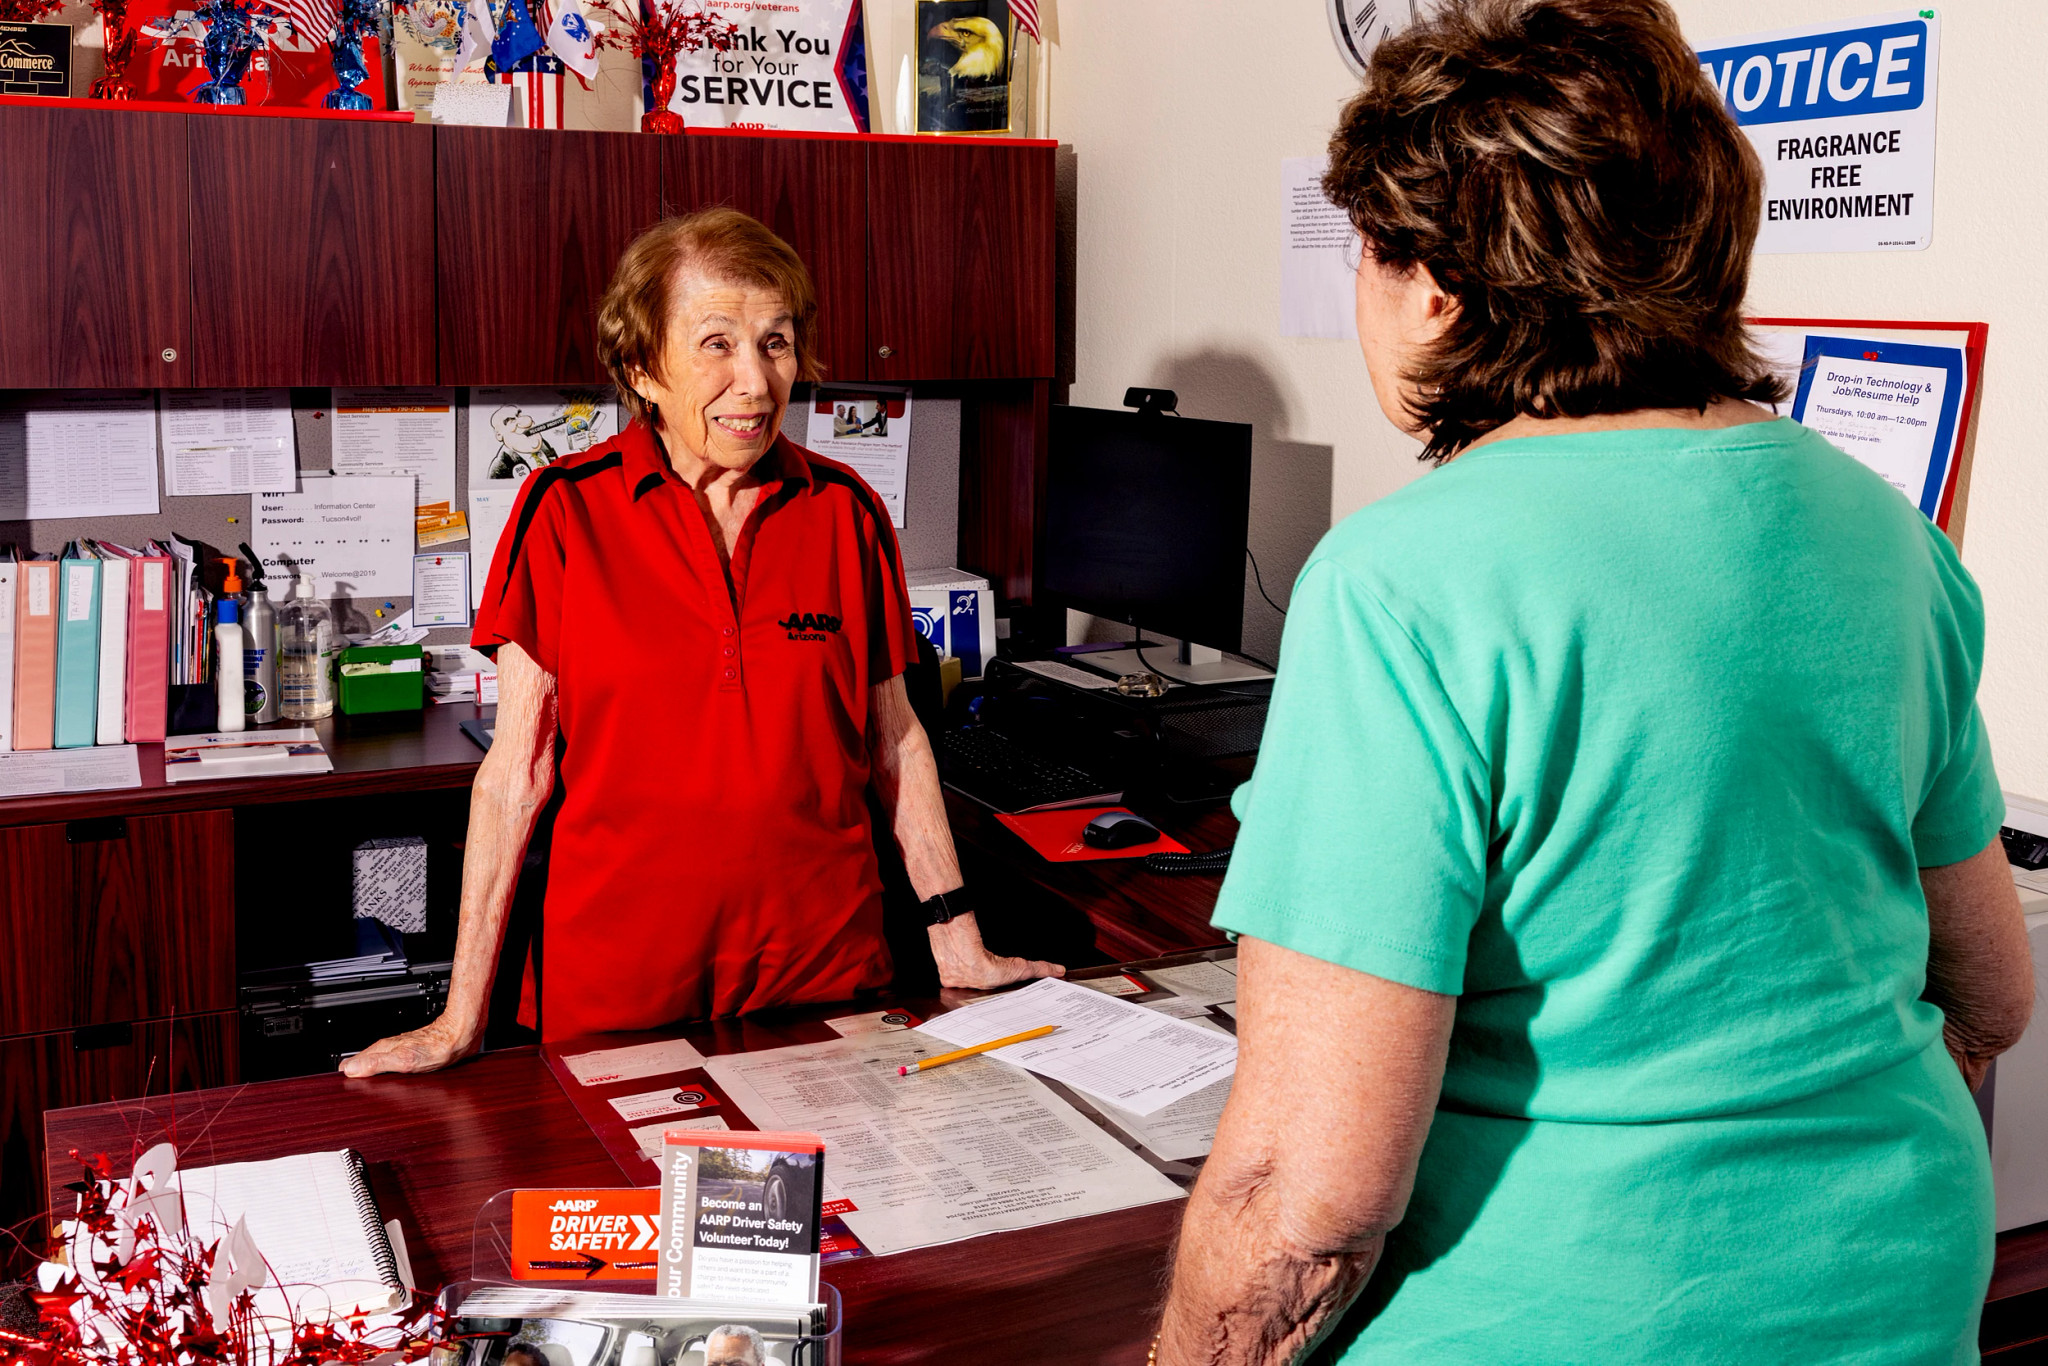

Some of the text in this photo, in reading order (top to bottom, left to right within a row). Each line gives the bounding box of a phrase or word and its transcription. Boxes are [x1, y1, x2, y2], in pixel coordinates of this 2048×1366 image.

[707, 0, 799, 13] aarp.org/veterans
[776, 29, 830, 56] You
[0, 53, 53, 70] Commerce
[712, 53, 799, 76] for Your
[1699, 34, 1920, 113] NOTICE
[681, 75, 833, 109] SERVICE
[1777, 130, 1901, 161] FRAGRANCE
[1811, 165, 1862, 189] FREE
[1768, 193, 1914, 221] ENVIRONMENT
[1827, 372, 1932, 394] Drop-in Technology &
[1832, 386, 1919, 406] Job/Resume Help
[1816, 405, 1854, 417] Thursdays,
[1856, 411, 1876, 420] 10:00
[314, 502, 352, 511] Information
[262, 558, 315, 567] Computer
[321, 570, 376, 578] Welcome@2019
[787, 631, 826, 643] Arizona
[548, 1200, 598, 1212] AARP
[666, 1151, 692, 1263] Community
[701, 1197, 762, 1211] Become an
[550, 1215, 628, 1232] DRIVER
[700, 1216, 803, 1234] AARP Driver Safety
[550, 1233, 631, 1250] SAFETY
[700, 1232, 789, 1251] Volunteer Today!
